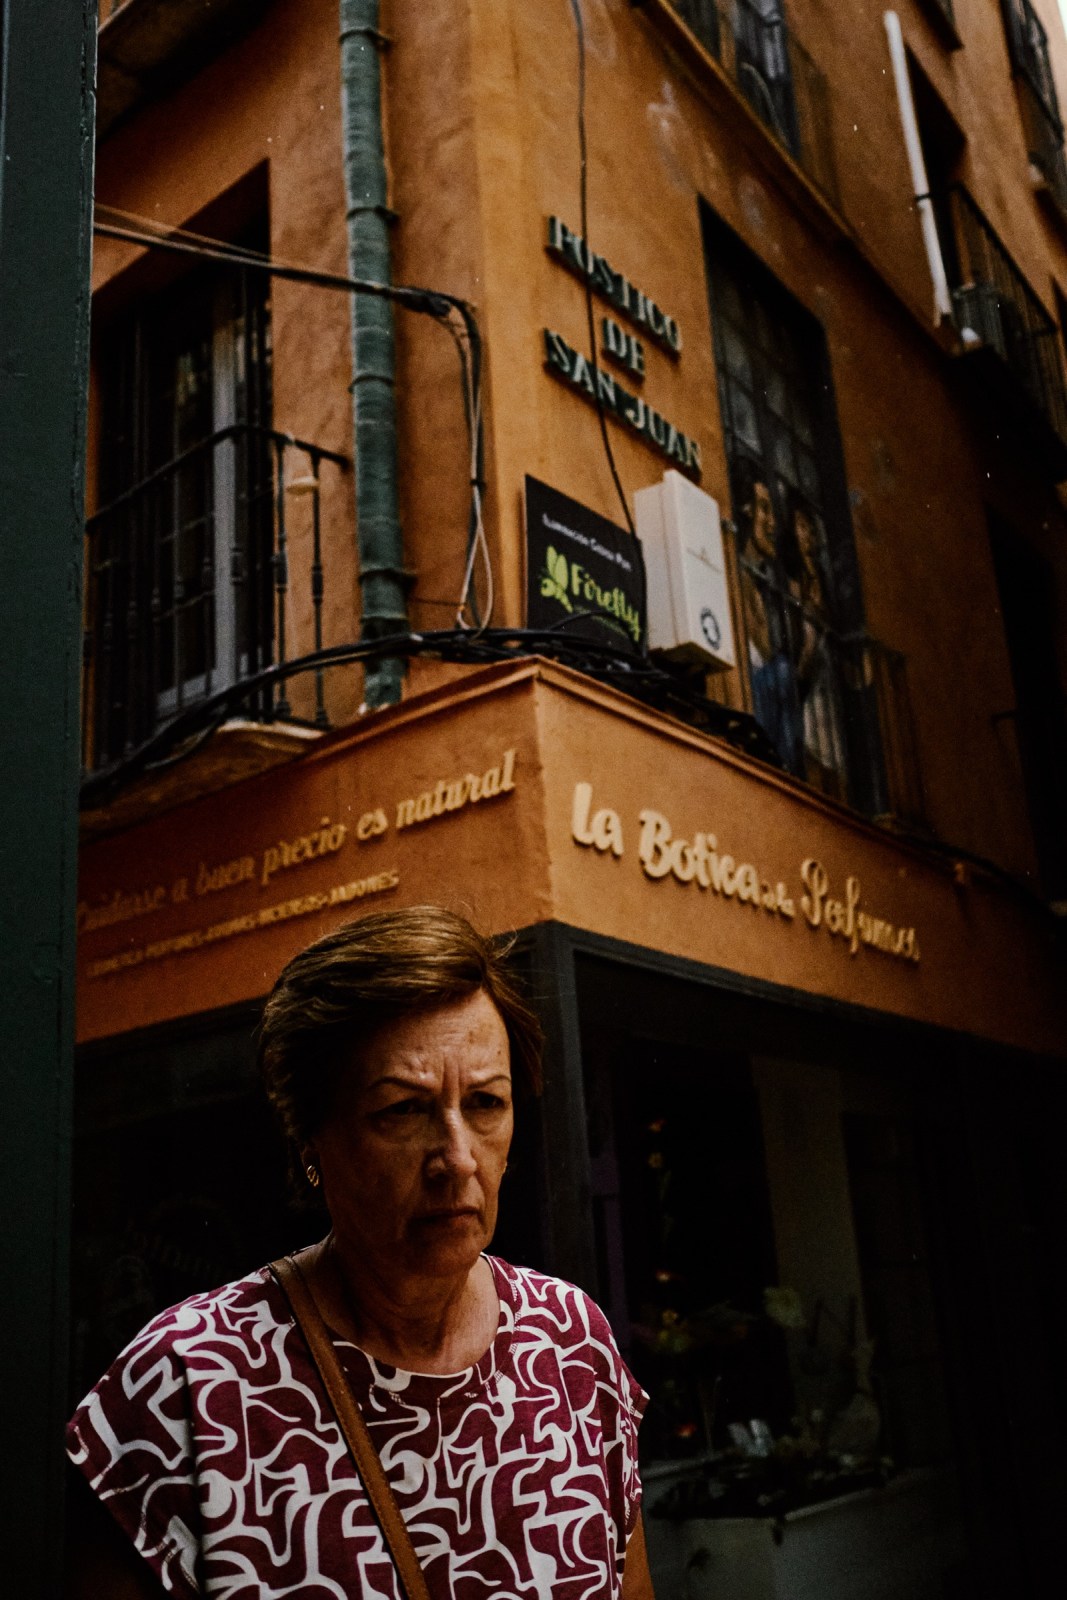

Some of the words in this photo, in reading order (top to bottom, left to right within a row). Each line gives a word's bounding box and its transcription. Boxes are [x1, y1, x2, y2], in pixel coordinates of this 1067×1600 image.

[544, 328, 618, 407] SAN
[624, 397, 702, 470] JUAN
[603, 317, 646, 377] DE
[260, 815, 349, 887] precio
[356, 807, 389, 842] es
[395, 747, 517, 830] natural
[638, 808, 761, 907] Botica
